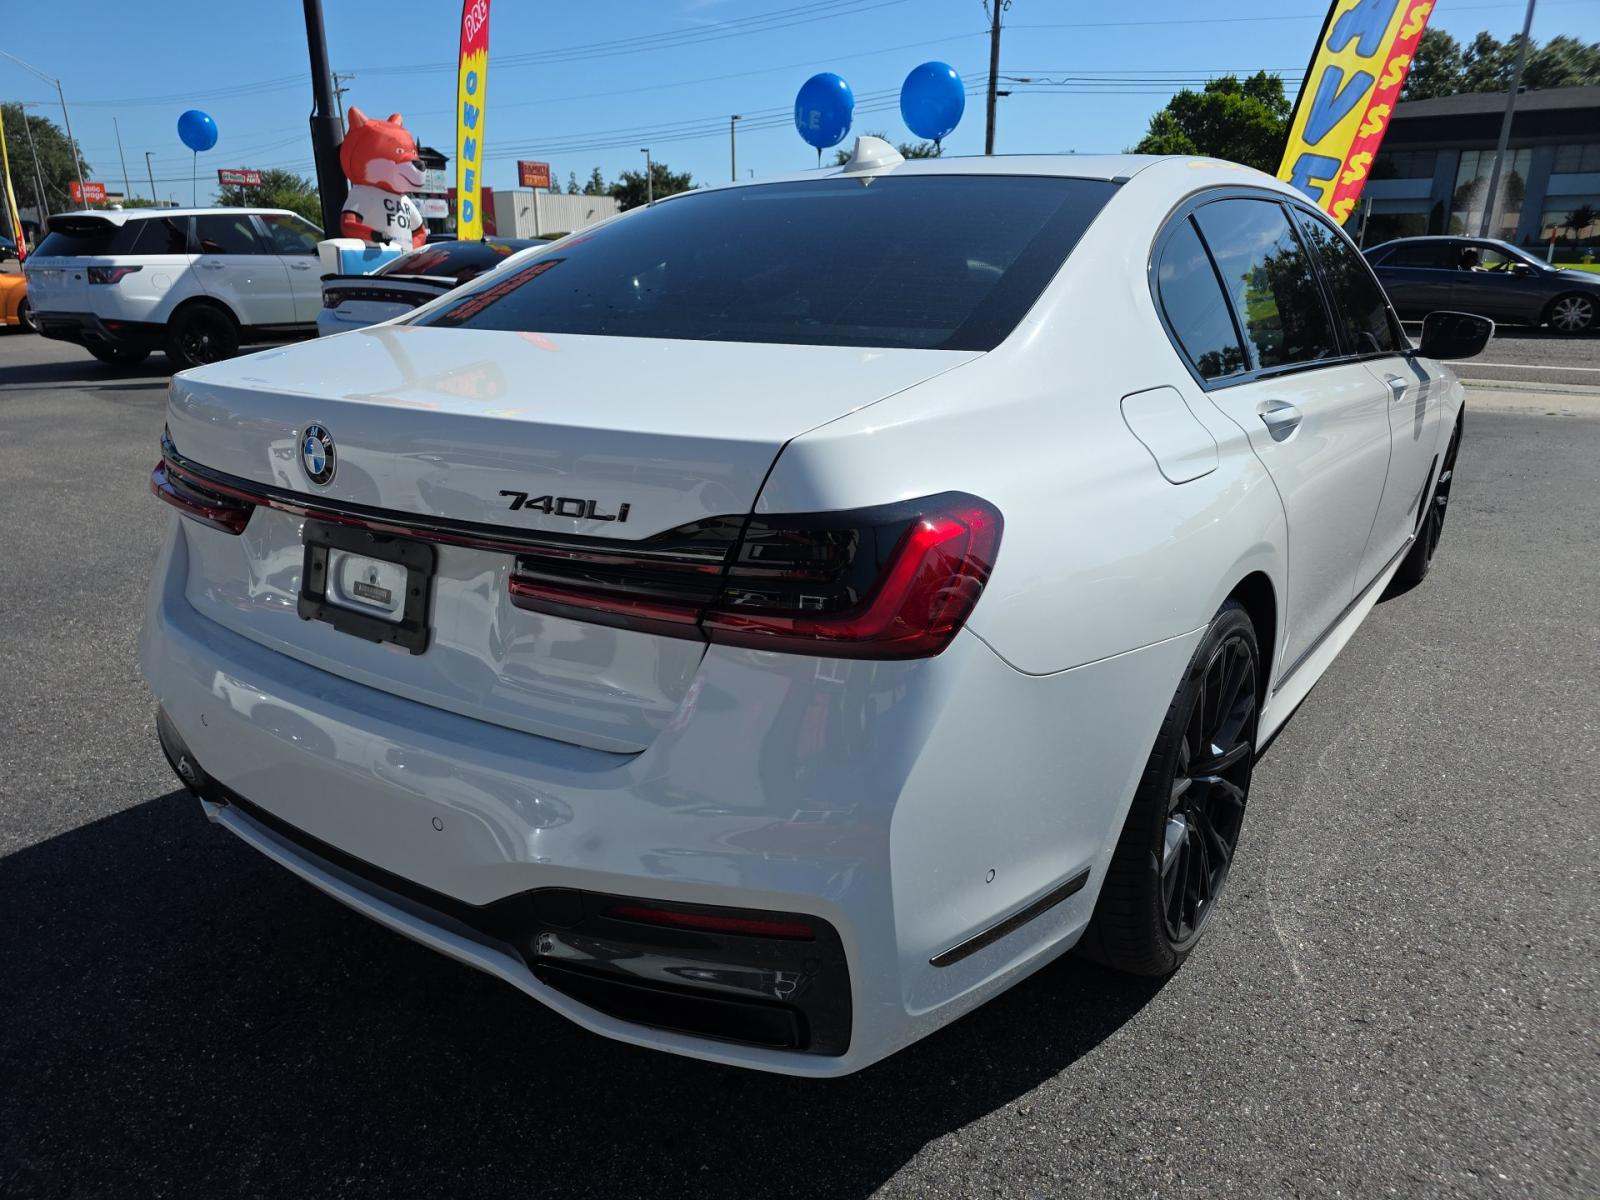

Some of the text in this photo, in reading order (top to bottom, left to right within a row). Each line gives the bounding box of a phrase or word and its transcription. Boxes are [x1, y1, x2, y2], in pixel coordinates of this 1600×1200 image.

[464, 0, 487, 42] PRE
[463, 70, 480, 224] OWNED
[383, 198, 410, 215] CAR
